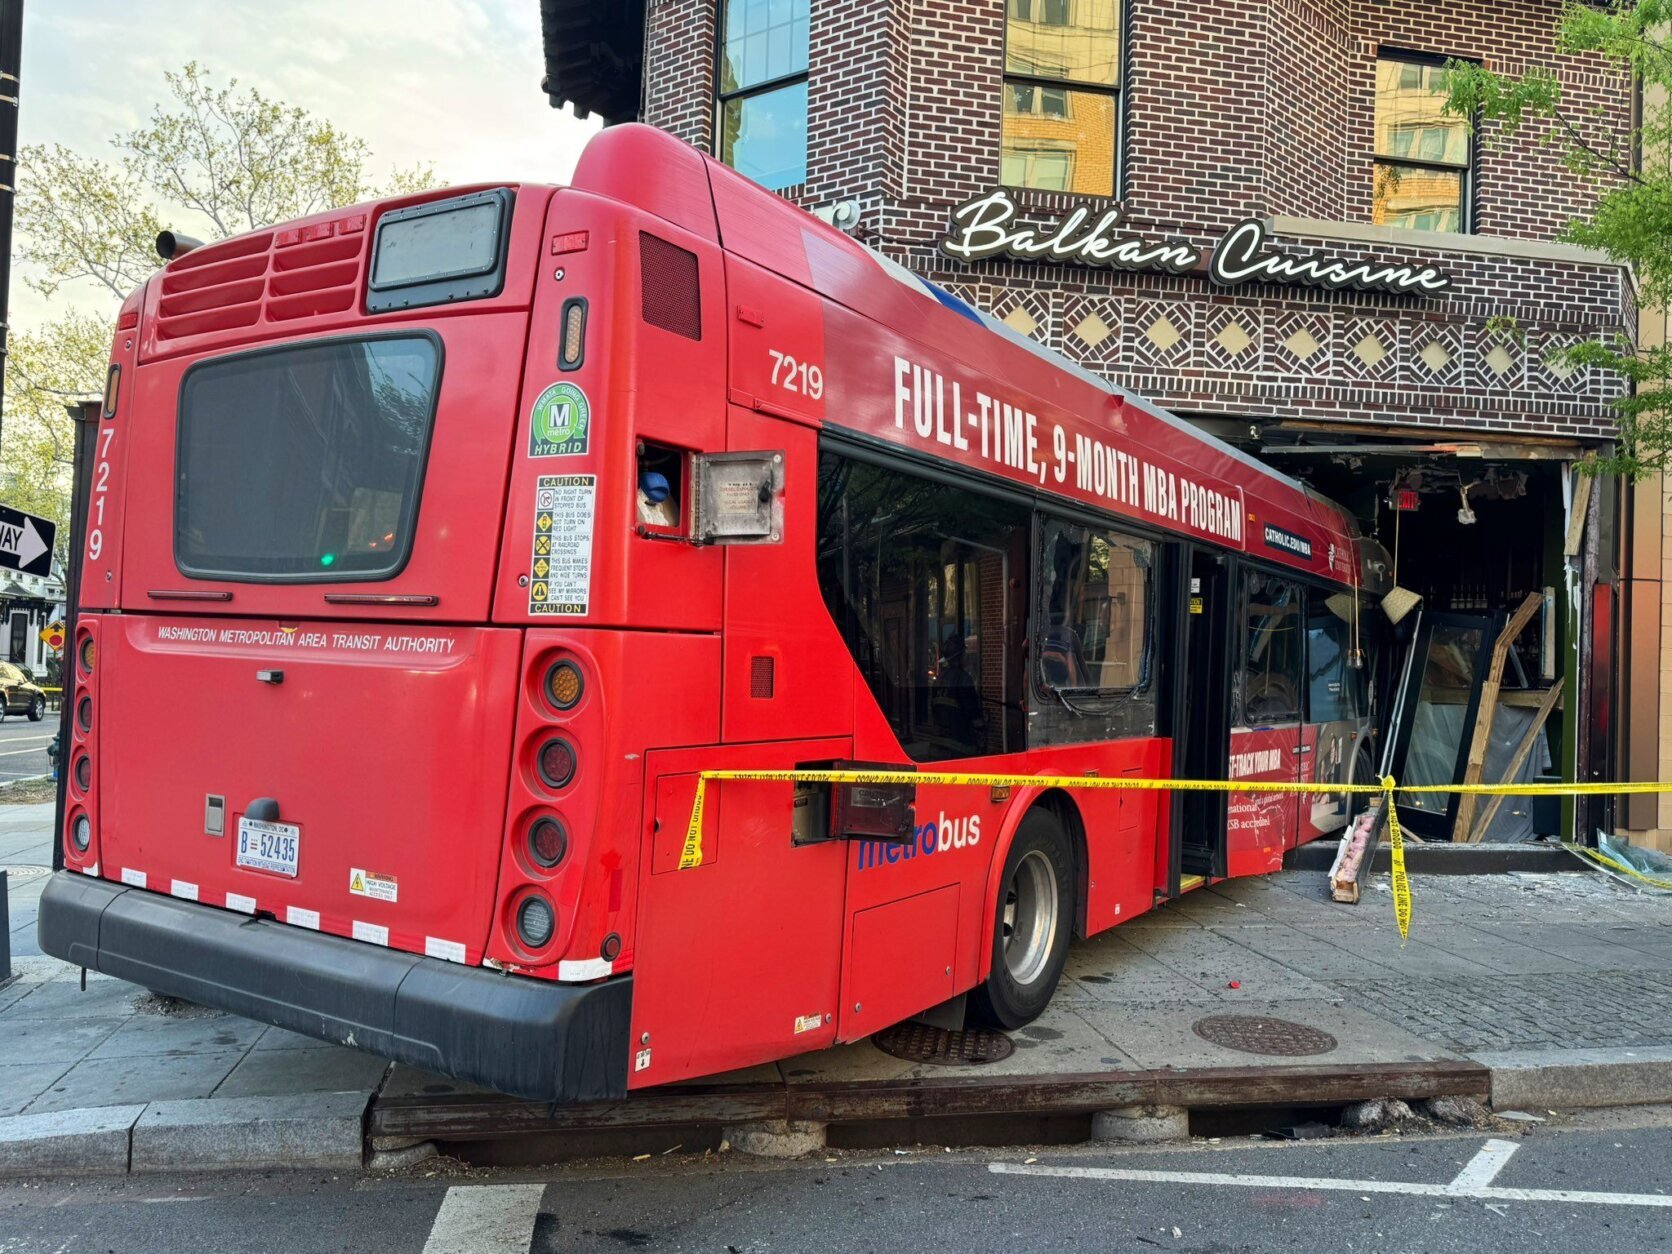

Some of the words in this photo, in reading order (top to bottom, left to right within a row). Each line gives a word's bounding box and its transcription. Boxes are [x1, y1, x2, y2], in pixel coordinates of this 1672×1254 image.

[946, 192, 1197, 266] Balkan
[1217, 223, 1452, 289] Cuisine
[768, 348, 824, 401] 7219
[549, 403, 570, 427] M
[547, 428, 571, 436] metro
[534, 442, 582, 455] HYBRID
[894, 355, 1047, 484] FULL-TIME,
[1053, 424, 1139, 507] 9-MONTH
[1142, 461, 1178, 521] MBA
[1180, 477, 1241, 542] PROGRAM
[89, 429, 115, 560] 7219
[543, 477, 589, 487] CAUTION
[535, 604, 581, 613] CAUTION
[158, 626, 217, 642] WASHINGTON
[219, 629, 295, 646] METROPOLITAN
[297, 632, 327, 648] AREA
[332, 634, 381, 650] TRANSIT
[384, 636, 455, 654] AUTHORITY
[240, 830, 248, 854] B
[260, 833, 295, 862] 52435
[378, 882, 396, 890] VOLTAGE
